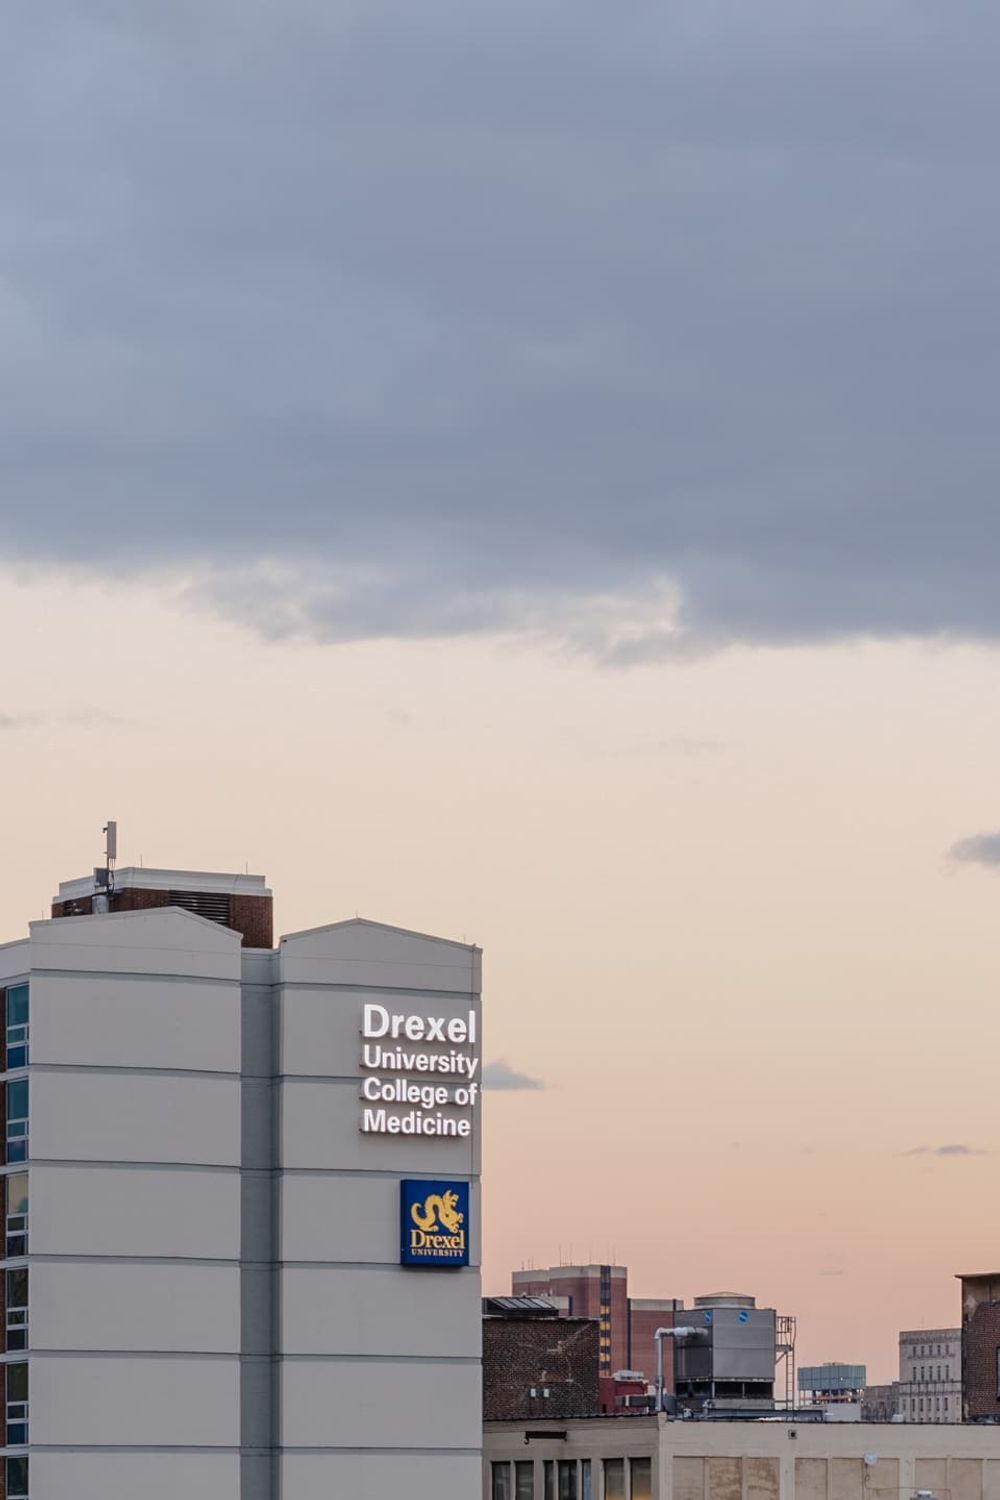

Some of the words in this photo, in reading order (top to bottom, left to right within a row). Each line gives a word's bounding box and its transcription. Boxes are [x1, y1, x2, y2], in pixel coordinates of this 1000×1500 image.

[363, 1004, 476, 1043] Drexel
[363, 1045, 478, 1078] University
[363, 1077, 448, 1109] College
[454, 1083, 477, 1106] of
[363, 1109, 471, 1136] Medicine
[410, 1229, 465, 1249] Drexel
[411, 1248, 464, 1257] UNIVERSITY
